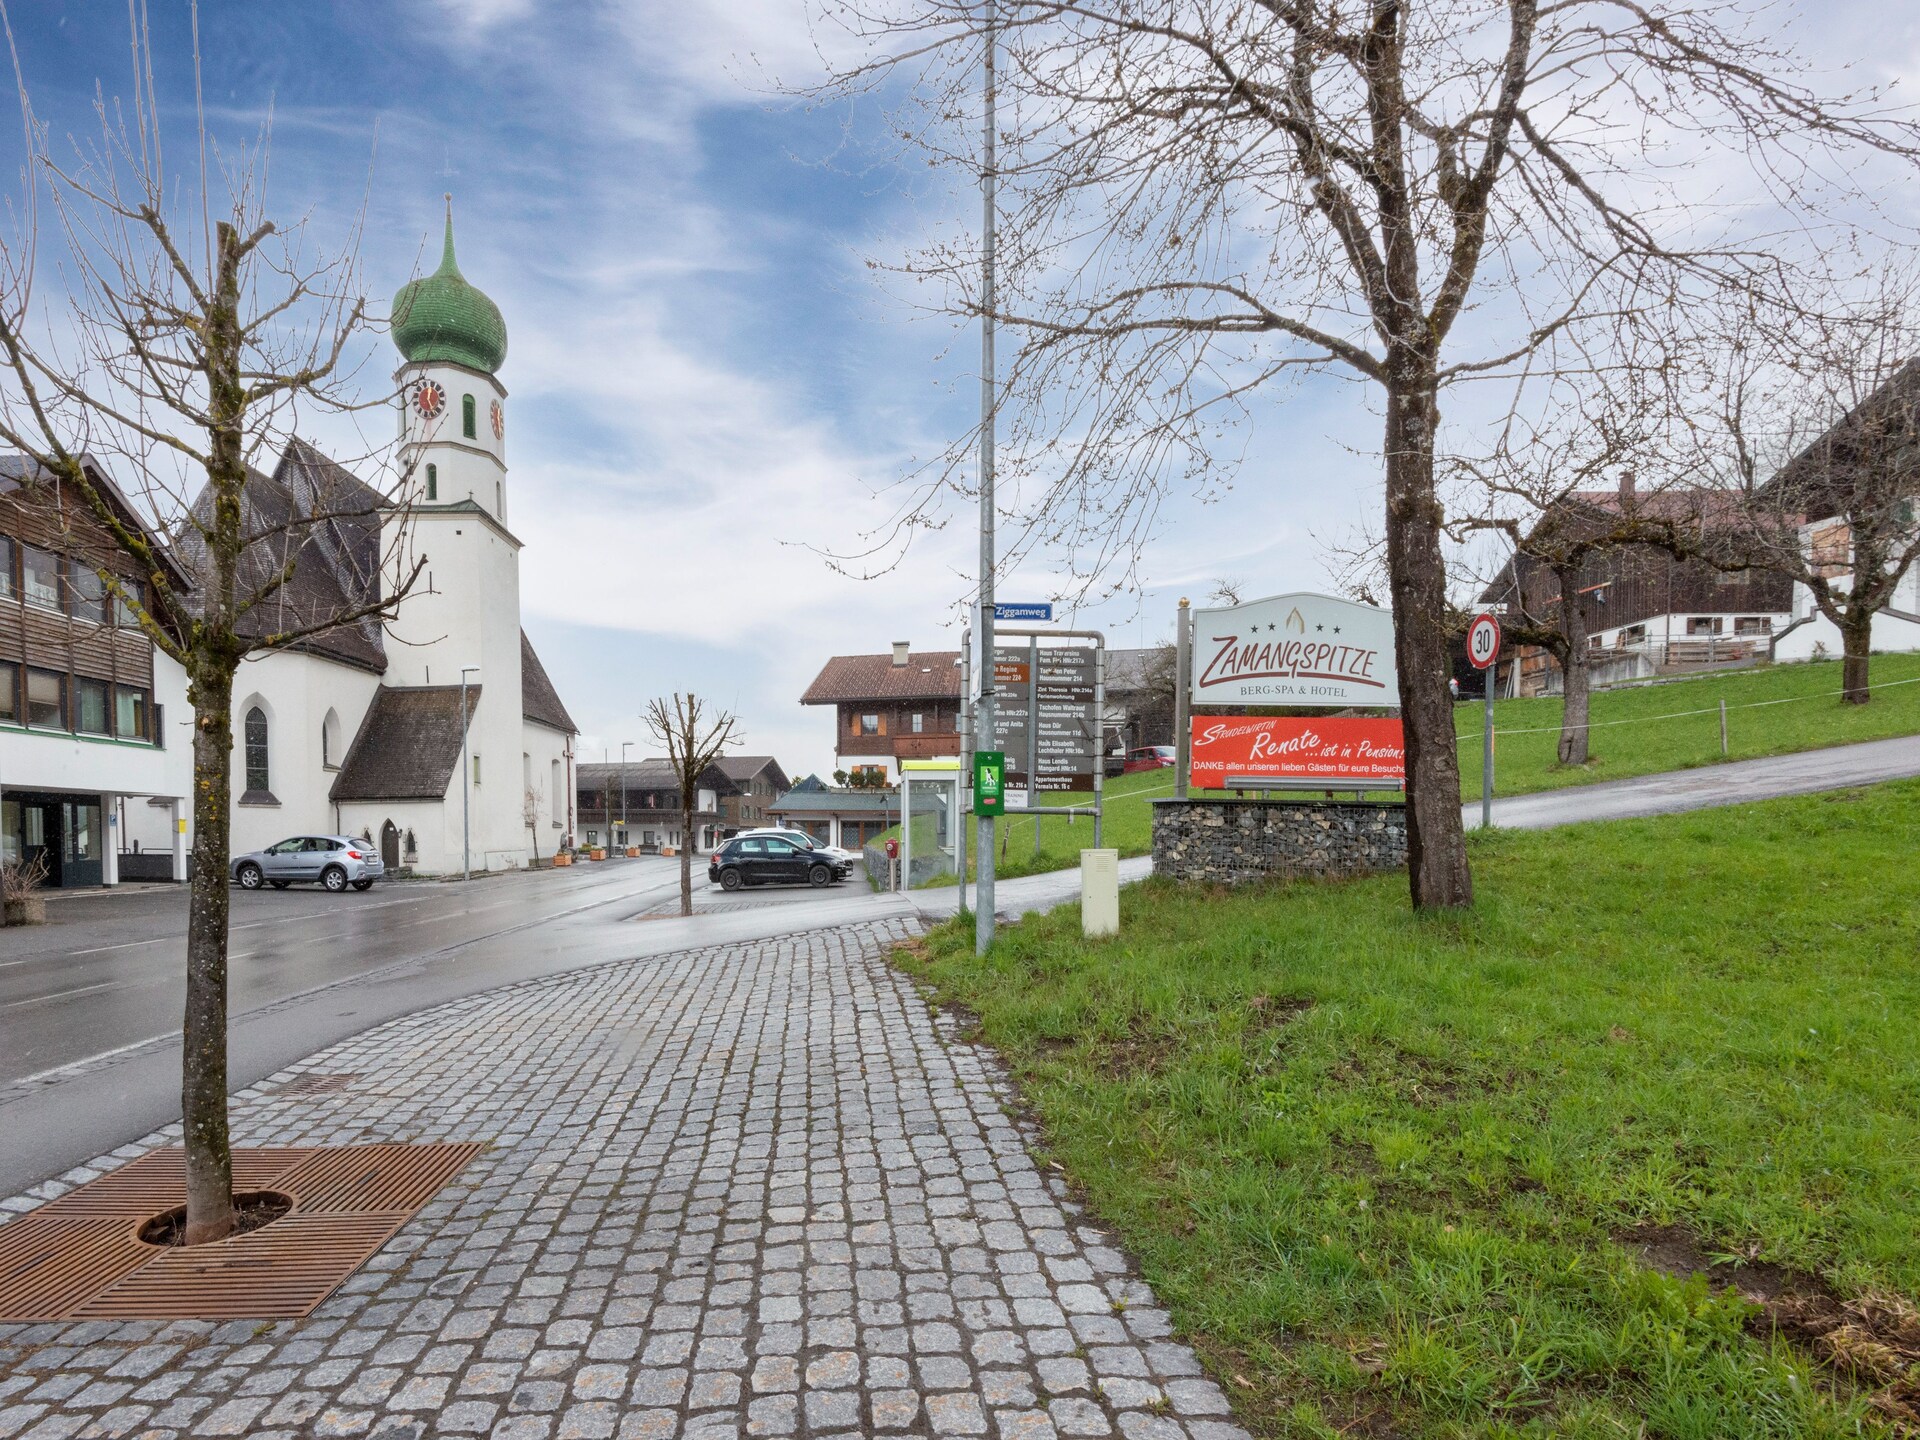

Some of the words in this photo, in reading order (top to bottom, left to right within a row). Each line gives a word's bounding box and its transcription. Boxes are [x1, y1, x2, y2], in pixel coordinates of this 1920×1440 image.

[996, 606, 1046, 618] Ziggamweg
[1476, 629, 1490, 654] 30
[1199, 636, 1385, 688] ZAMANGSPITZE
[1240, 685, 1295, 696] BERG-SPA
[1299, 685, 1307, 695] &
[1311, 685, 1348, 698] HOTEL
[1194, 720, 1277, 746] STRUDELWIRTIN
[1249, 729, 1321, 760] Renate
[1341, 744, 1351, 758] in
[1357, 740, 1405, 759] Pension!
[1193, 761, 1224, 770] DANKE
[1226, 761, 1245, 771] allen
[1247, 762, 1280, 771] unseren
[1281, 762, 1306, 772] lieben
[1307, 762, 1337, 772] Gästen
[1338, 763, 1349, 772] für
[1351, 765, 1370, 773] eure
[1035, 776, 1073, 784] Appartementhaus
